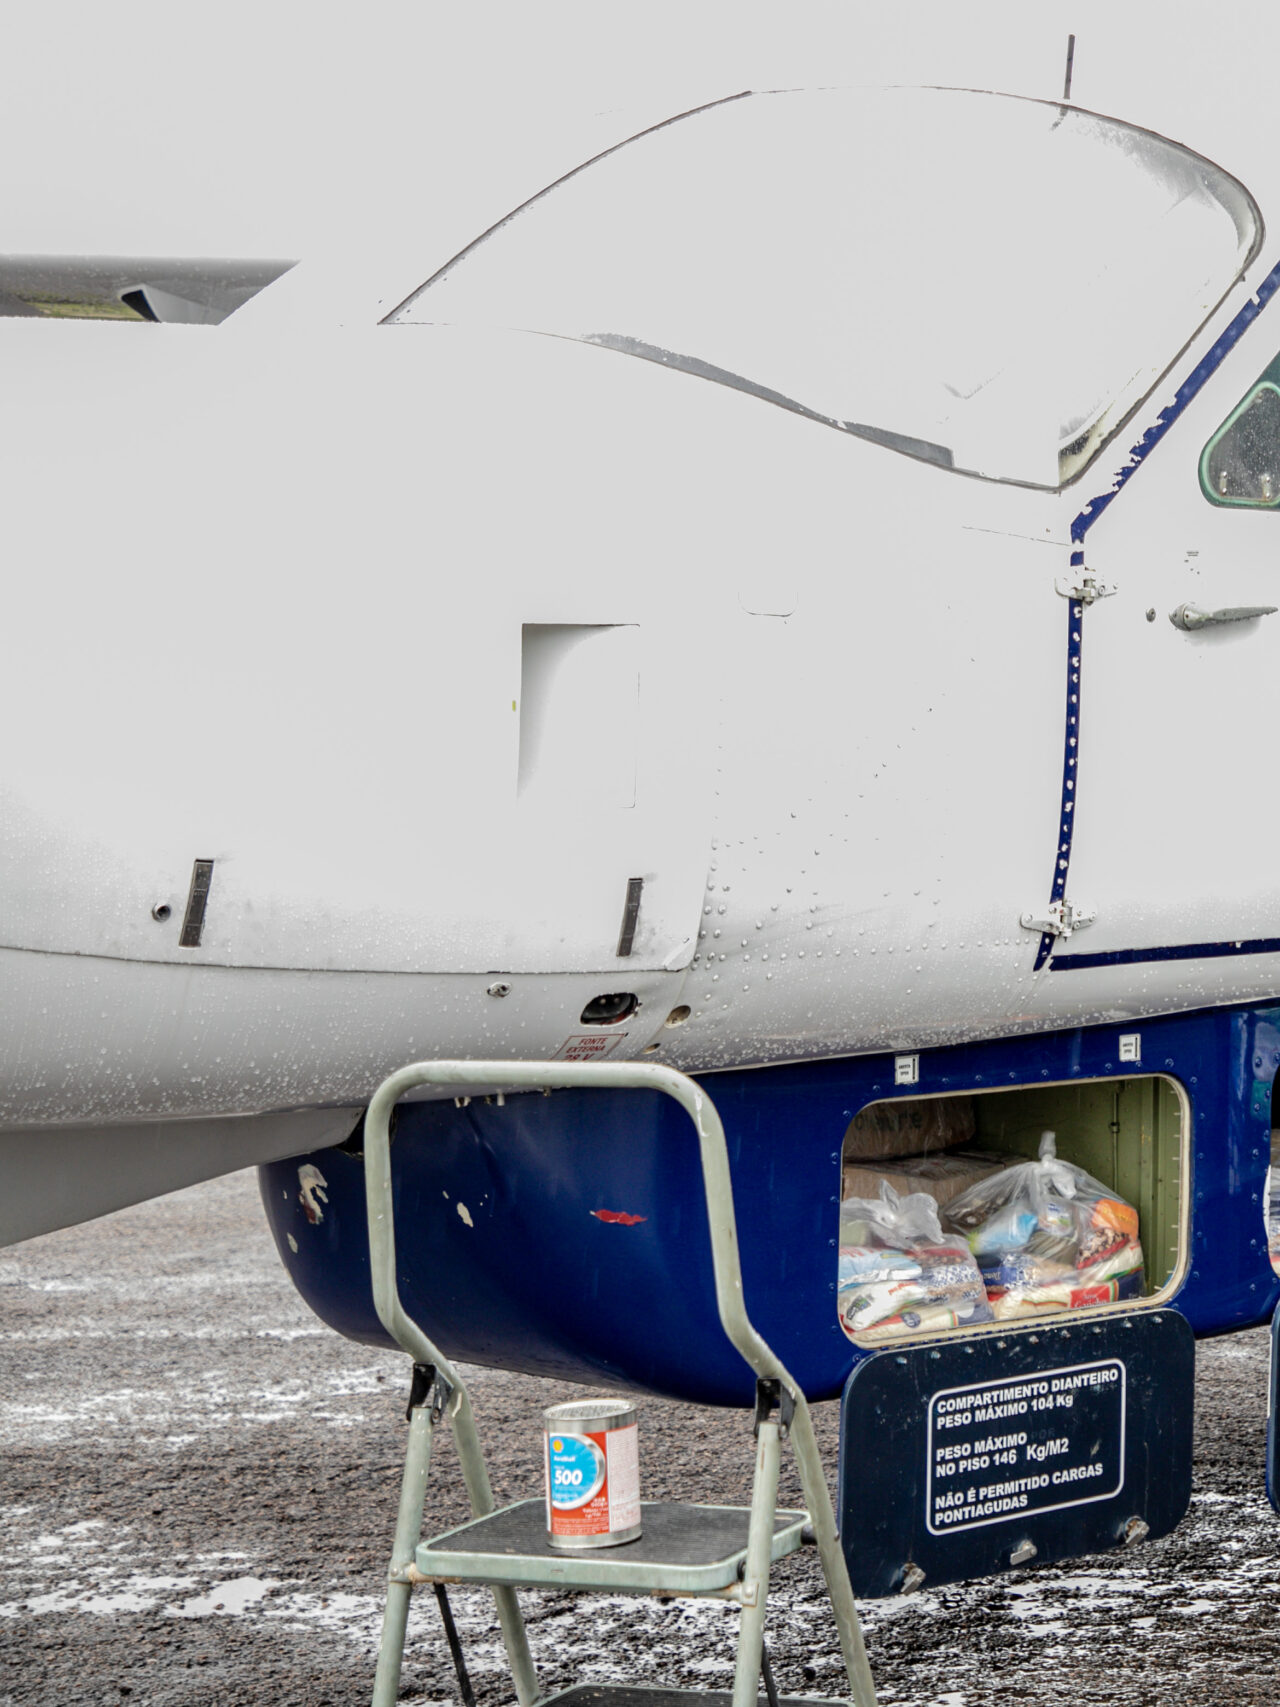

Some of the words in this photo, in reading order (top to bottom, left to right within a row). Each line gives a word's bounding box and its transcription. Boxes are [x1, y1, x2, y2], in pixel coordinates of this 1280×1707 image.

[579, 1037, 608, 1045] FONTE
[937, 1382, 1049, 1413] COMPARTIMENTO
[1051, 1369, 1119, 1392] DIANTEIRO
[937, 1412, 971, 1429] PESO
[975, 1402, 1027, 1423] MÁXIMO
[1031, 1394, 1054, 1411] 104
[1056, 1394, 1073, 1408] Kg
[936, 1444, 971, 1461] PESO
[974, 1432, 1027, 1454] MÁXIMO
[936, 1463, 955, 1477] NO
[959, 1455, 990, 1473] PISO
[993, 1450, 1016, 1466] 146
[1027, 1438, 1069, 1461] Kg/M2
[554, 1469, 583, 1485] 500
[935, 1492, 963, 1509] NÃO
[967, 1488, 976, 1503] É
[979, 1475, 1049, 1500] PERMITIDO
[1052, 1463, 1103, 1484] CARGAS
[935, 1495, 1028, 1525] PONTIAGUDAS
